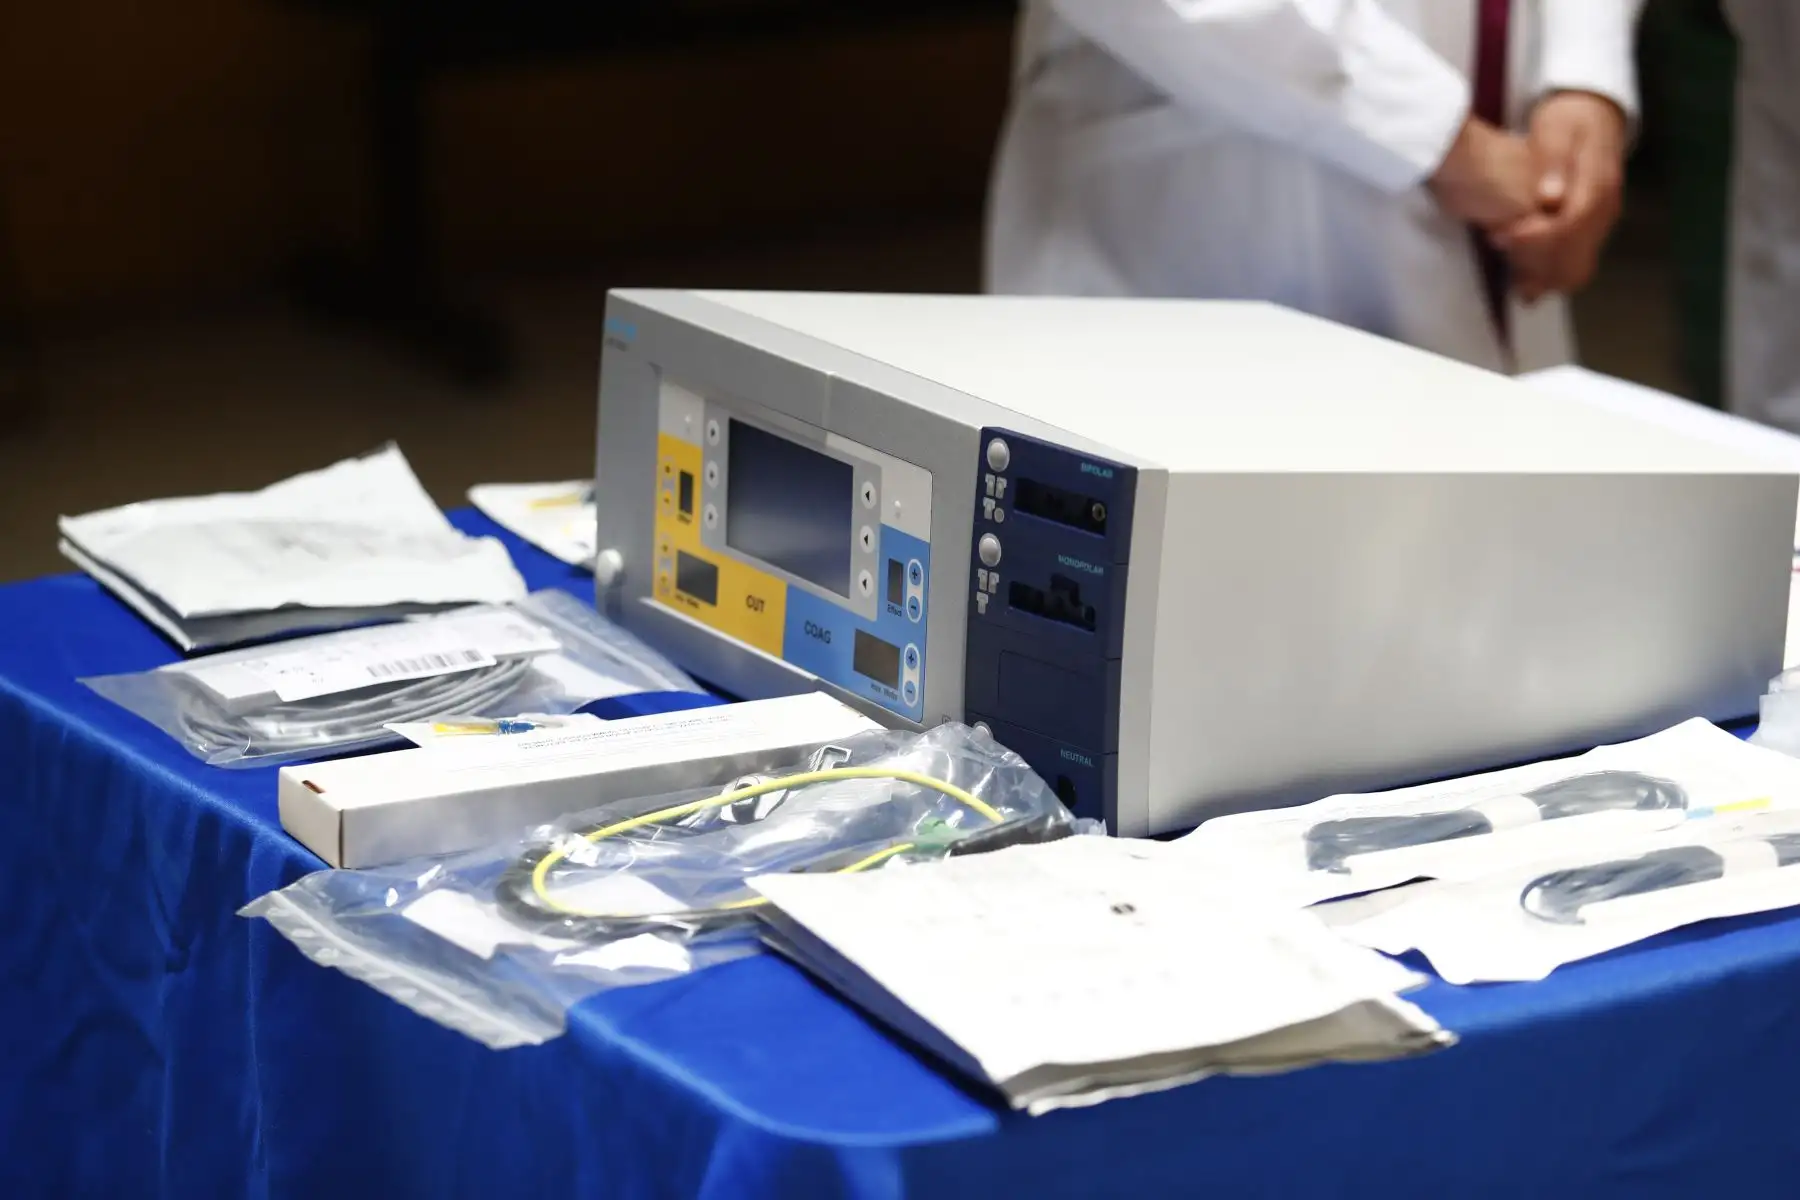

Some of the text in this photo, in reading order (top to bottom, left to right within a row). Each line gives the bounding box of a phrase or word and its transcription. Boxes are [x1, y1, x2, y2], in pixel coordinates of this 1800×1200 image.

[1058, 554, 1104, 576] MONOPOLAR
[746, 594, 765, 613] CUT
[804, 620, 831, 644] COAG
[1060, 748, 1095, 768] NEUTRAL
